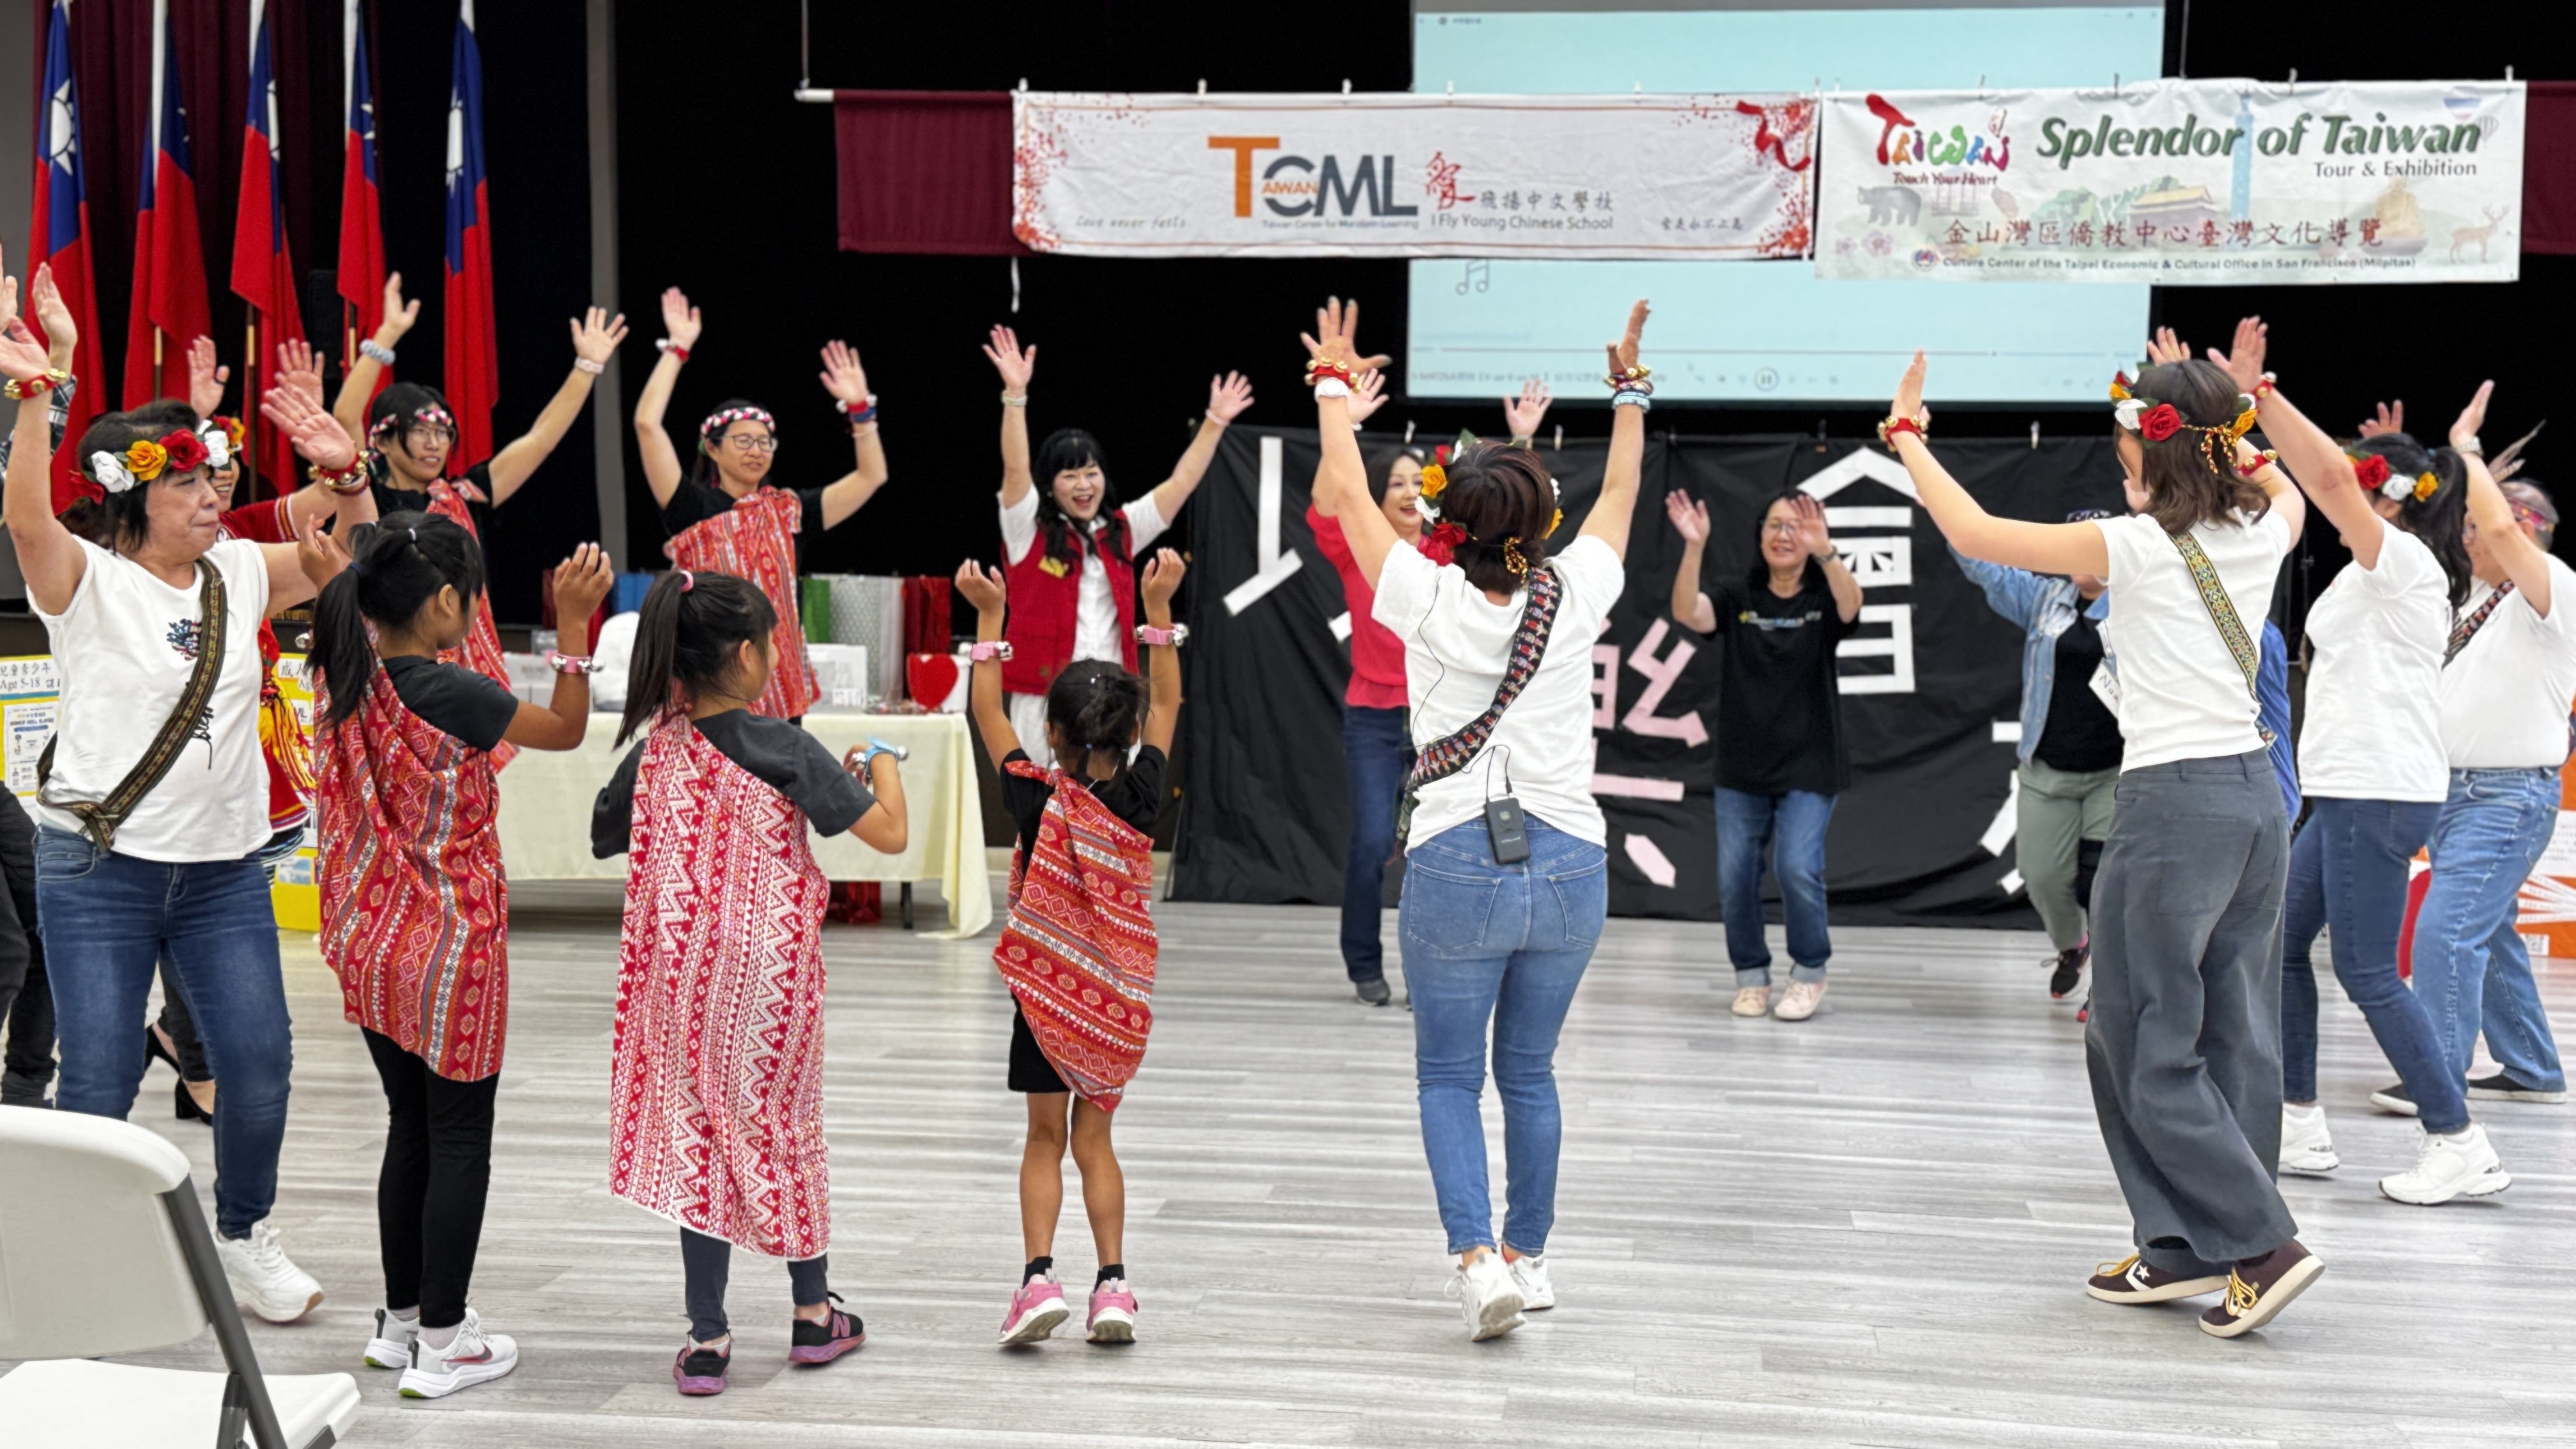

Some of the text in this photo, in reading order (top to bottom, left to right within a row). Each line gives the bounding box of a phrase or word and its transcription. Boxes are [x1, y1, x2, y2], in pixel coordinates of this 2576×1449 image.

[2036, 112, 2481, 170] Splendor of Taiwan
[1208, 136, 1418, 217] TCML
[2314, 159, 2476, 178] Tour & Exhibition
[1893, 171, 1998, 185] Touch Your Heart
[1439, 214, 1459, 229] Fly
[1462, 214, 1506, 231] Young
[1509, 215, 1563, 229] Chinese
[1567, 216, 1614, 230] School
[1943, 257, 1984, 266] Culture
[1988, 257, 2025, 267] Center
[2028, 257, 2041, 267] of
[2043, 258, 2062, 268] the
[2065, 259, 2099, 270] Taipei
[2102, 259, 2158, 269] Economic
[2175, 259, 2220, 269] Cultural
[2223, 259, 2258, 268] Office
[2262, 259, 2273, 268] in
[2276, 258, 2298, 268] San
[2301, 258, 2356, 267] Francisco
[2359, 257, 2416, 268] (Milpitas)
